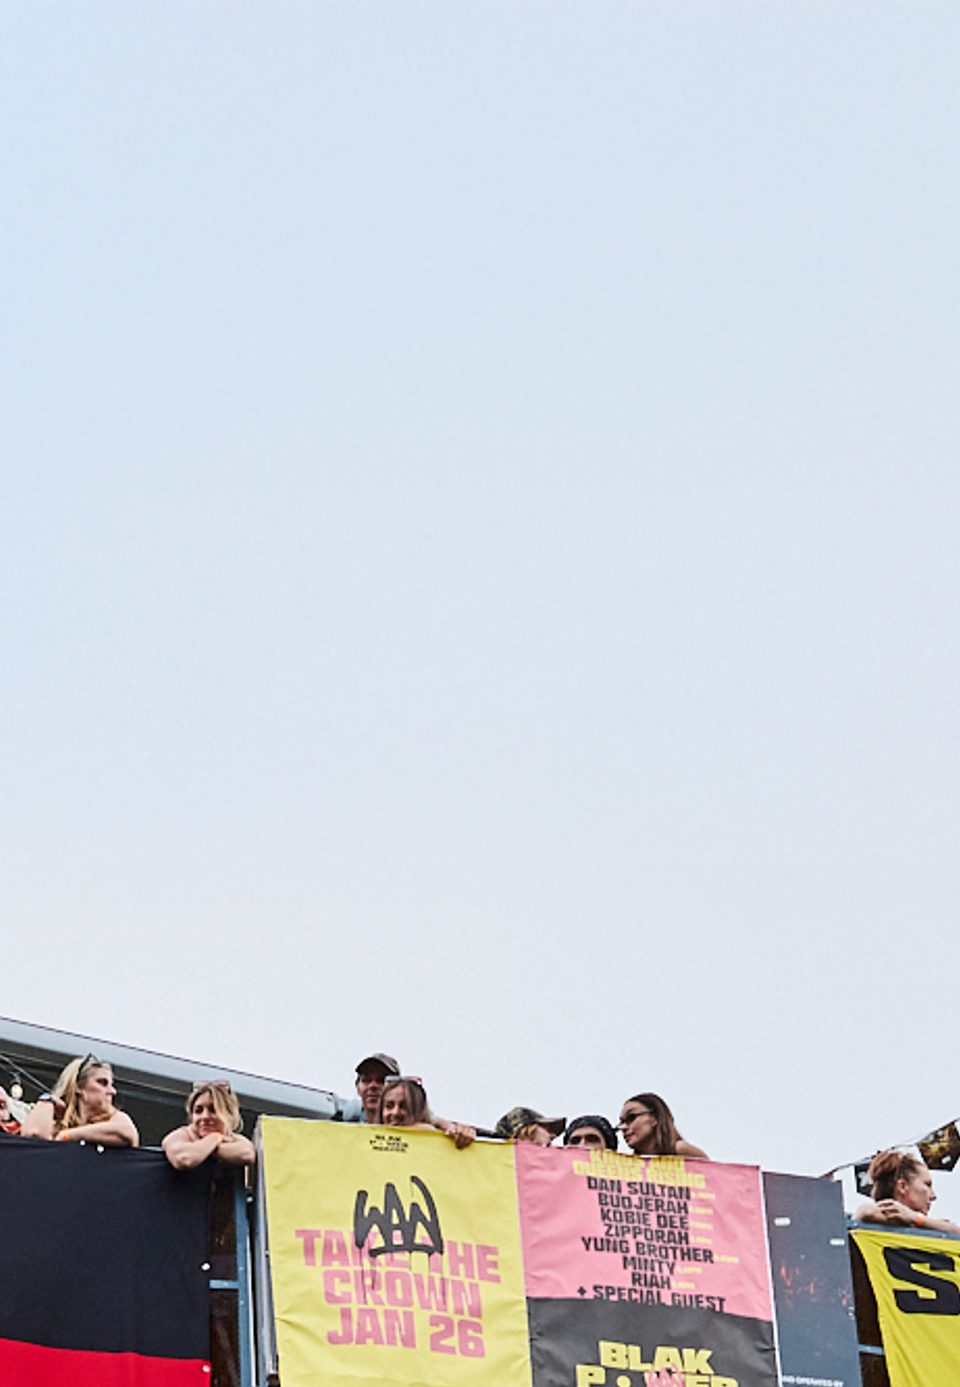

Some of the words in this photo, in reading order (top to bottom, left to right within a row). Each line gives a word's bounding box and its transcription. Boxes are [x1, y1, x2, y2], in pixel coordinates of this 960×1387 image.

[586, 1176, 623, 1194] DAN
[627, 1181, 691, 1201] SULTAN
[597, 1192, 689, 1215] BUDJERAH
[600, 1208, 652, 1227] KOBIE
[656, 1214, 690, 1231] DEE
[604, 1223, 690, 1246] ZIPPORAH
[295, 1228, 410, 1269] TAKE
[421, 1238, 501, 1284] THE
[581, 1236, 631, 1254] YUNG
[634, 1242, 715, 1265] BROTHER
[622, 1255, 676, 1276] MINTY
[322, 1267, 484, 1320] CROWN
[631, 1271, 672, 1290] RIAH
[592, 1284, 667, 1306] SPECIAL
[670, 1291, 727, 1313] GUEST
[326, 1306, 417, 1350] JAN
[428, 1313, 486, 1359] 26
[598, 1340, 715, 1375] BLAK
